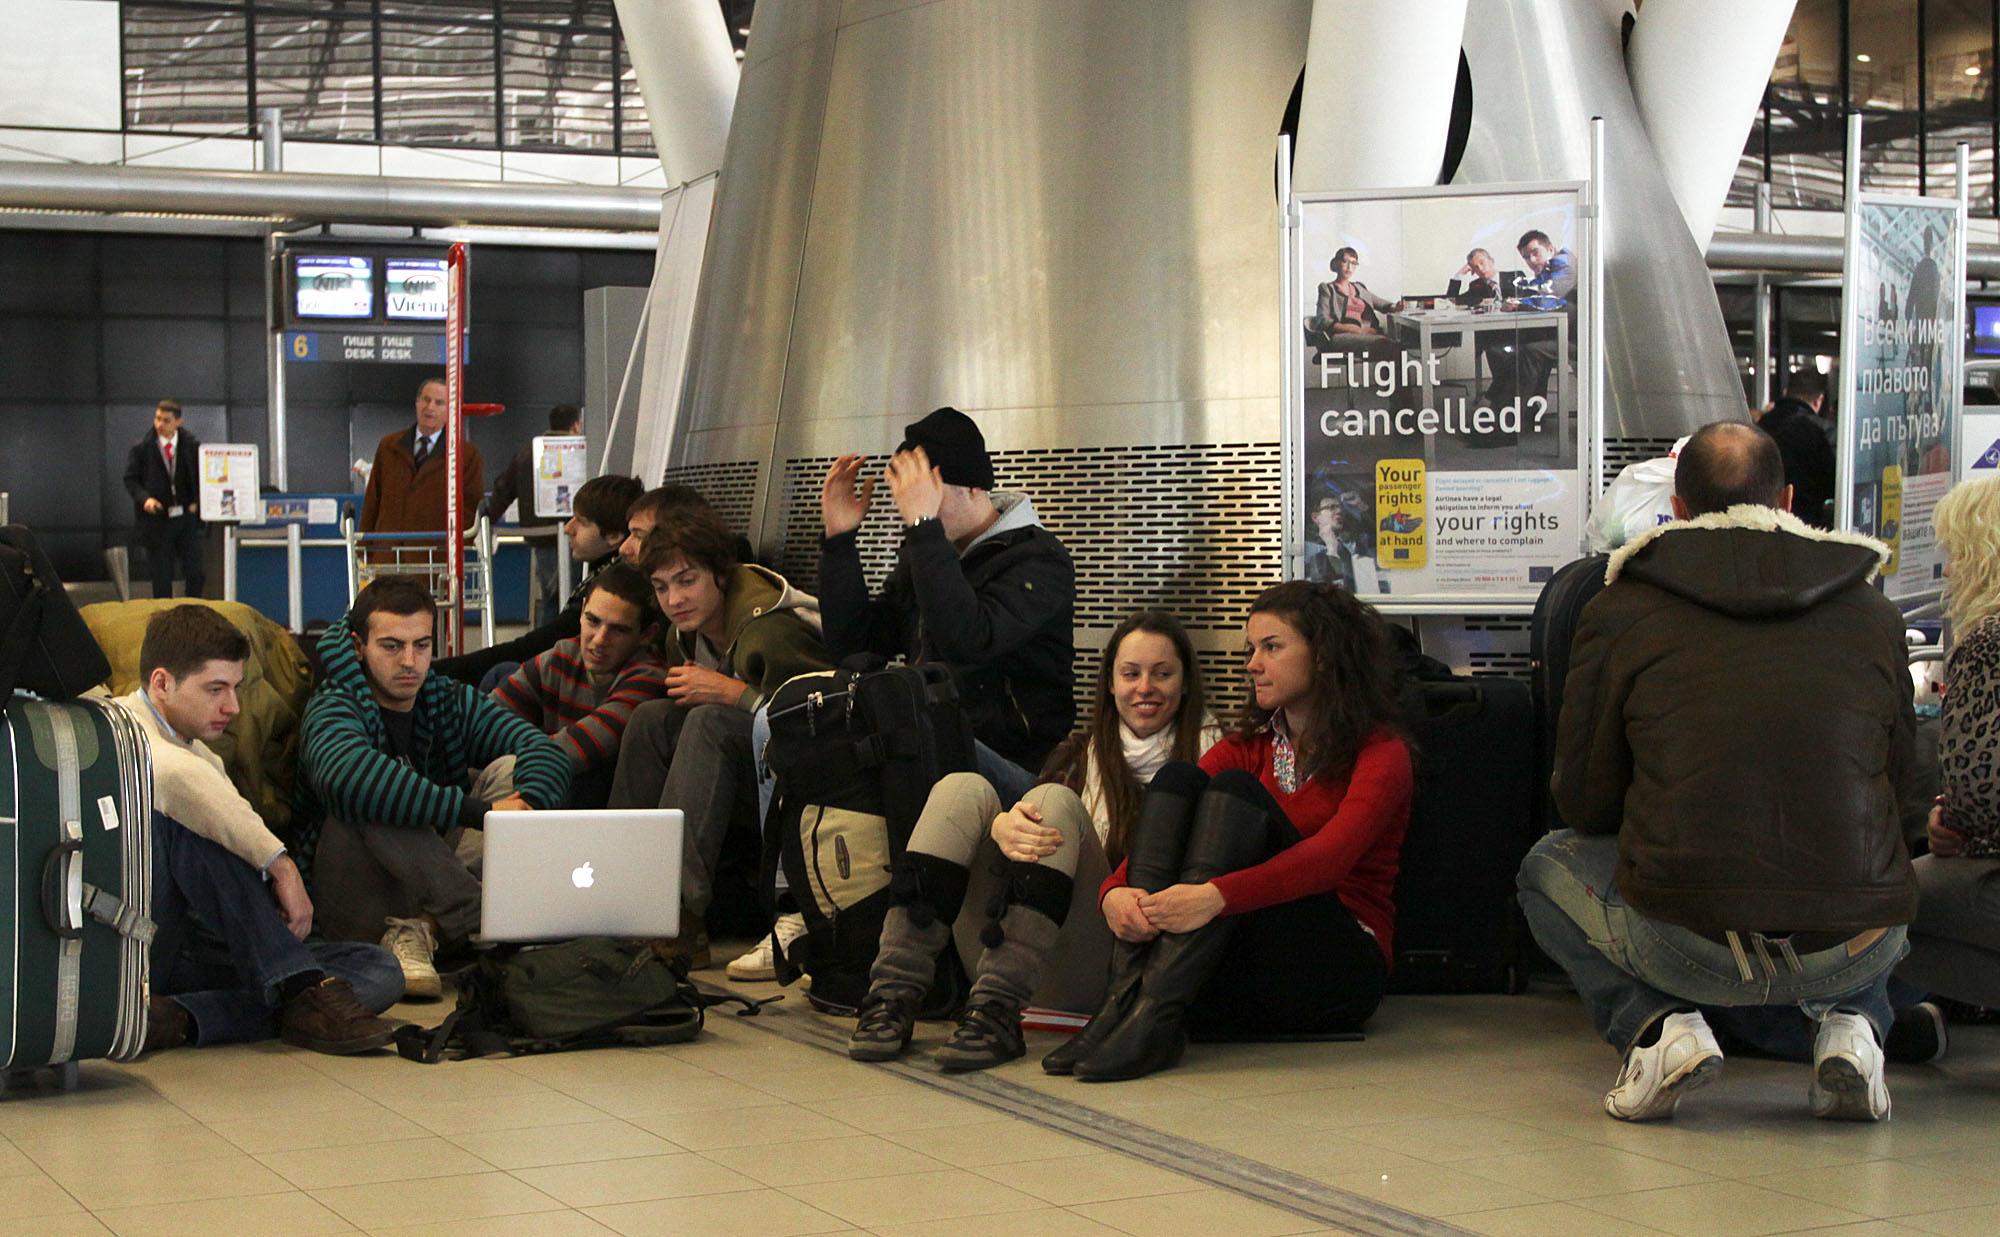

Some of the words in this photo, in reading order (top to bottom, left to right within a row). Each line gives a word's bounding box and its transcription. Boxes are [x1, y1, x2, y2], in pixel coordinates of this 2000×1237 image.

[393, 297, 449, 313] Vienn
[1863, 311, 1913, 346] Всеки
[1918, 318, 1945, 344] има
[293, 335, 308, 358] 6
[343, 336, 375, 346] ГИШЕ
[381, 336, 413, 347] ГИШЕ
[344, 349, 375, 359] DESK
[381, 349, 412, 360] DESK
[1320, 350, 1441, 398] Flight
[1862, 366, 1929, 404] правото
[1319, 395, 1548, 437] cancelled?
[1860, 416, 1881, 451] да
[1887, 411, 1940, 449] пътува
[1379, 466, 1422, 482] Your
[1379, 483, 1421, 491] passenger
[1379, 491, 1422, 507] rights
[1485, 495, 1502, 503] legal
[1435, 515, 1486, 535] your
[1493, 511, 1559, 535] rights
[1380, 536, 1391, 545] at
[1394, 535, 1423, 545] hand
[1435, 537, 1453, 545] and
[1455, 537, 1485, 545] where
[1488, 537, 1497, 545] to
[1499, 536, 1544, 547] complain
